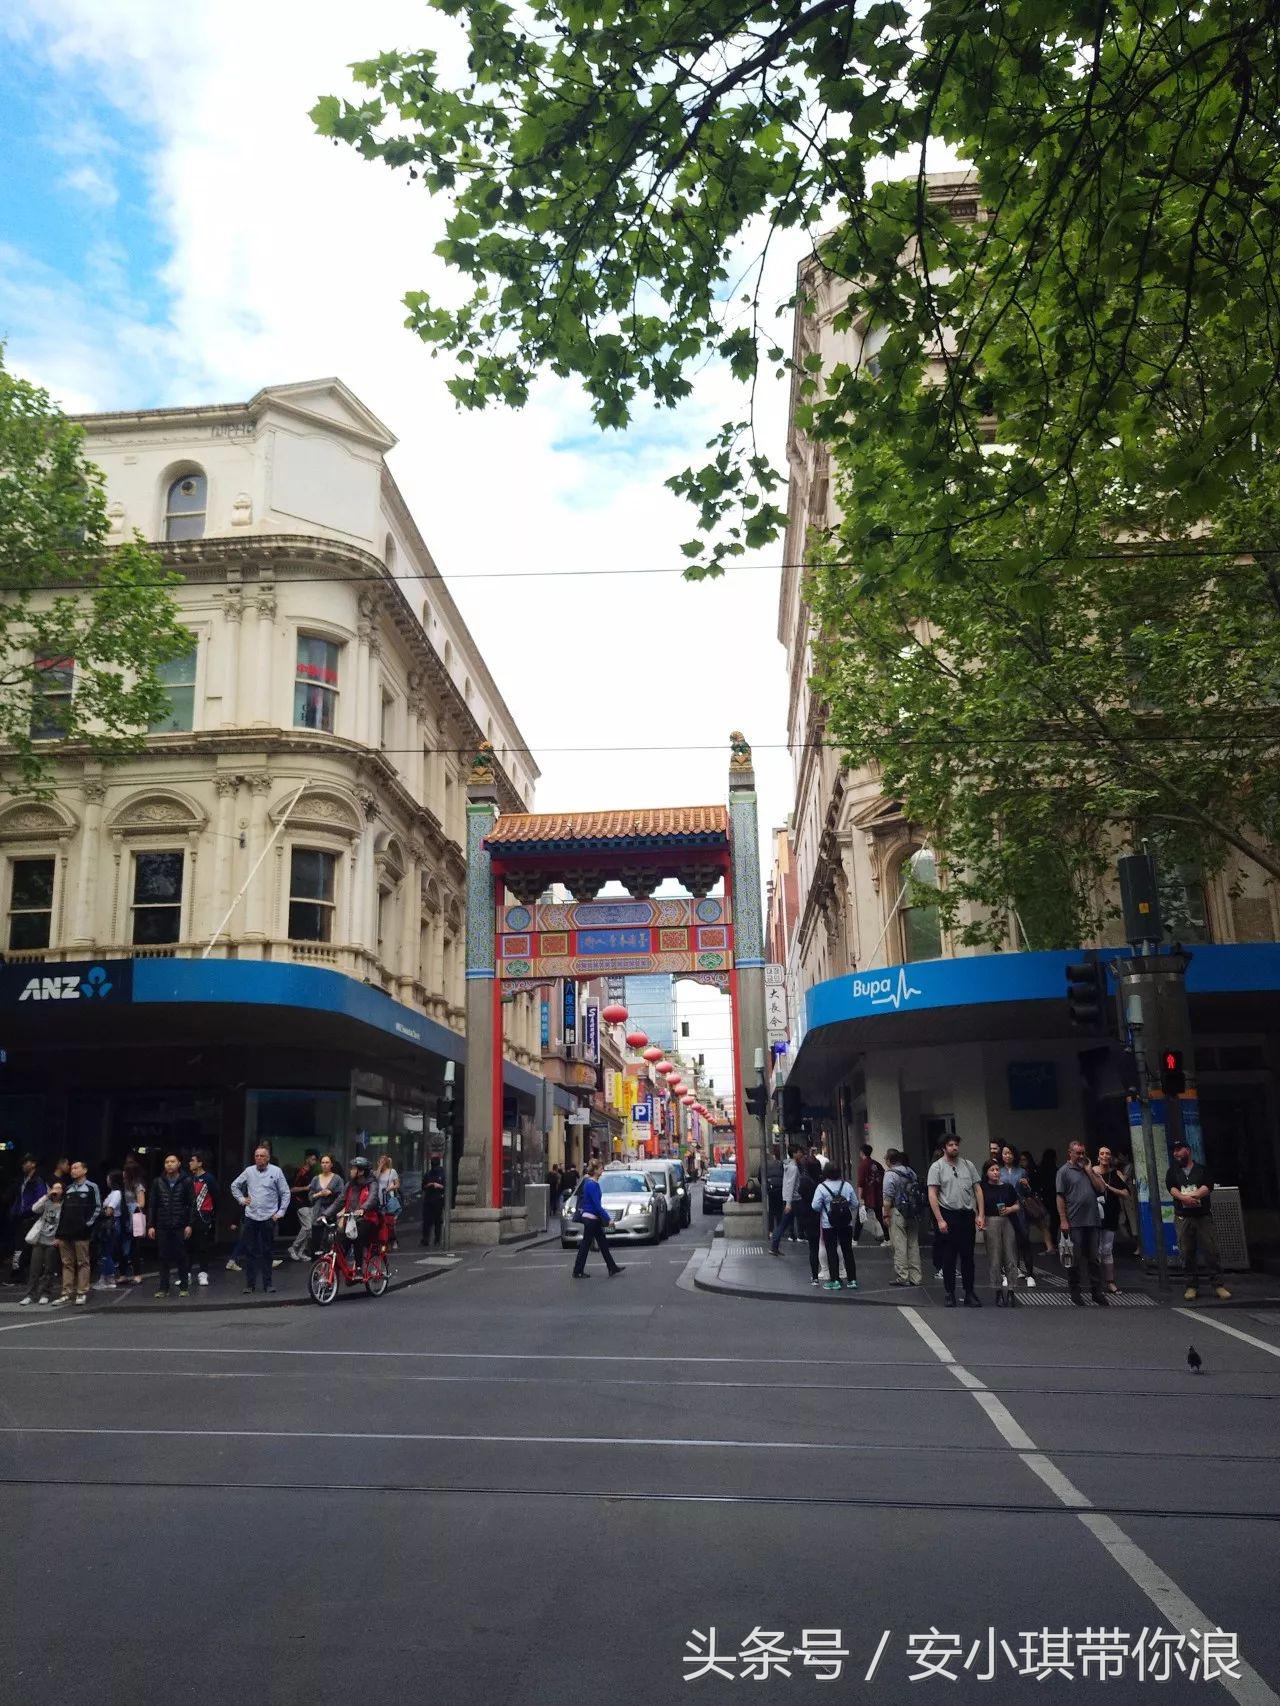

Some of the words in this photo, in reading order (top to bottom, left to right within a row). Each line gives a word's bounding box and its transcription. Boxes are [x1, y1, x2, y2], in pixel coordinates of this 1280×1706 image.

[19, 976, 80, 1000] ANZ
[853, 979, 891, 998] Bupa
[635, 1105, 647, 1120] P
